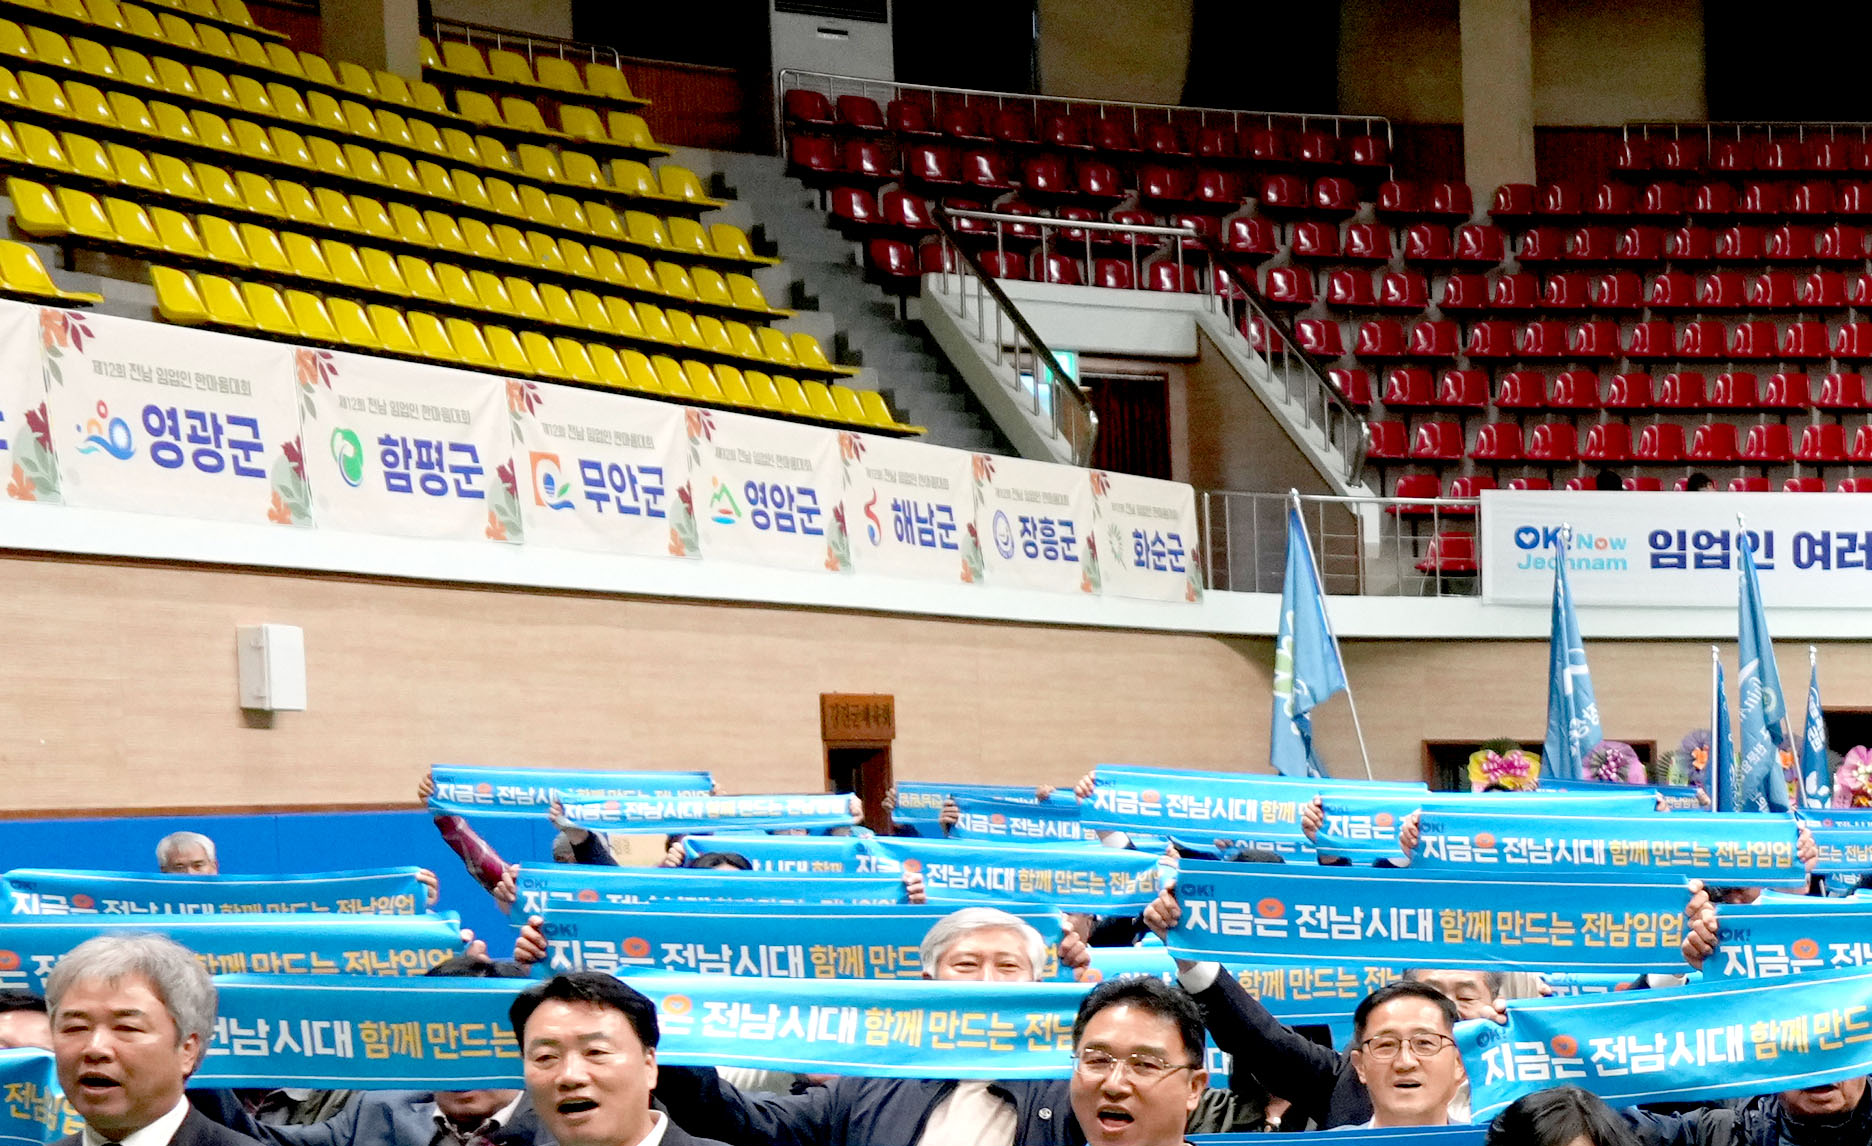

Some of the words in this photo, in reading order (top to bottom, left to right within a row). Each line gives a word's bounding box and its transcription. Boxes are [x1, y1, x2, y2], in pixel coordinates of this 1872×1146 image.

[129, 363, 153, 384] 전남
[157, 367, 191, 388] 임업인
[195, 371, 251, 396] 한마음대회
[368, 398, 387, 415] 전남
[142, 405, 267, 478] 영광군
[377, 434, 485, 499] 함평군
[578, 459, 666, 518] 무안군
[744, 480, 824, 536] 영암군
[891, 497, 959, 550] 해남군
[1018, 515, 1079, 563] 장흥군
[1132, 528, 1185, 573] 화순군
[1577, 533, 1627, 551] Now
[1095, 790, 1160, 817] 지금은
[1166, 796, 1257, 822] 전남시대
[1422, 832, 1499, 862] 지금은
[1503, 838, 1605, 866] 전남시대
[1609, 840, 1648, 867] 함께
[1652, 840, 1710, 867] 만드는
[1715, 840, 1792, 869] 전남임업
[1185, 898, 1288, 940] 지금은
[1295, 903, 1433, 943] 전남시대
[1440, 908, 1492, 945] 함께
[1496, 909, 1574, 947] 만드는
[1581, 910, 1684, 949] 전남임업
